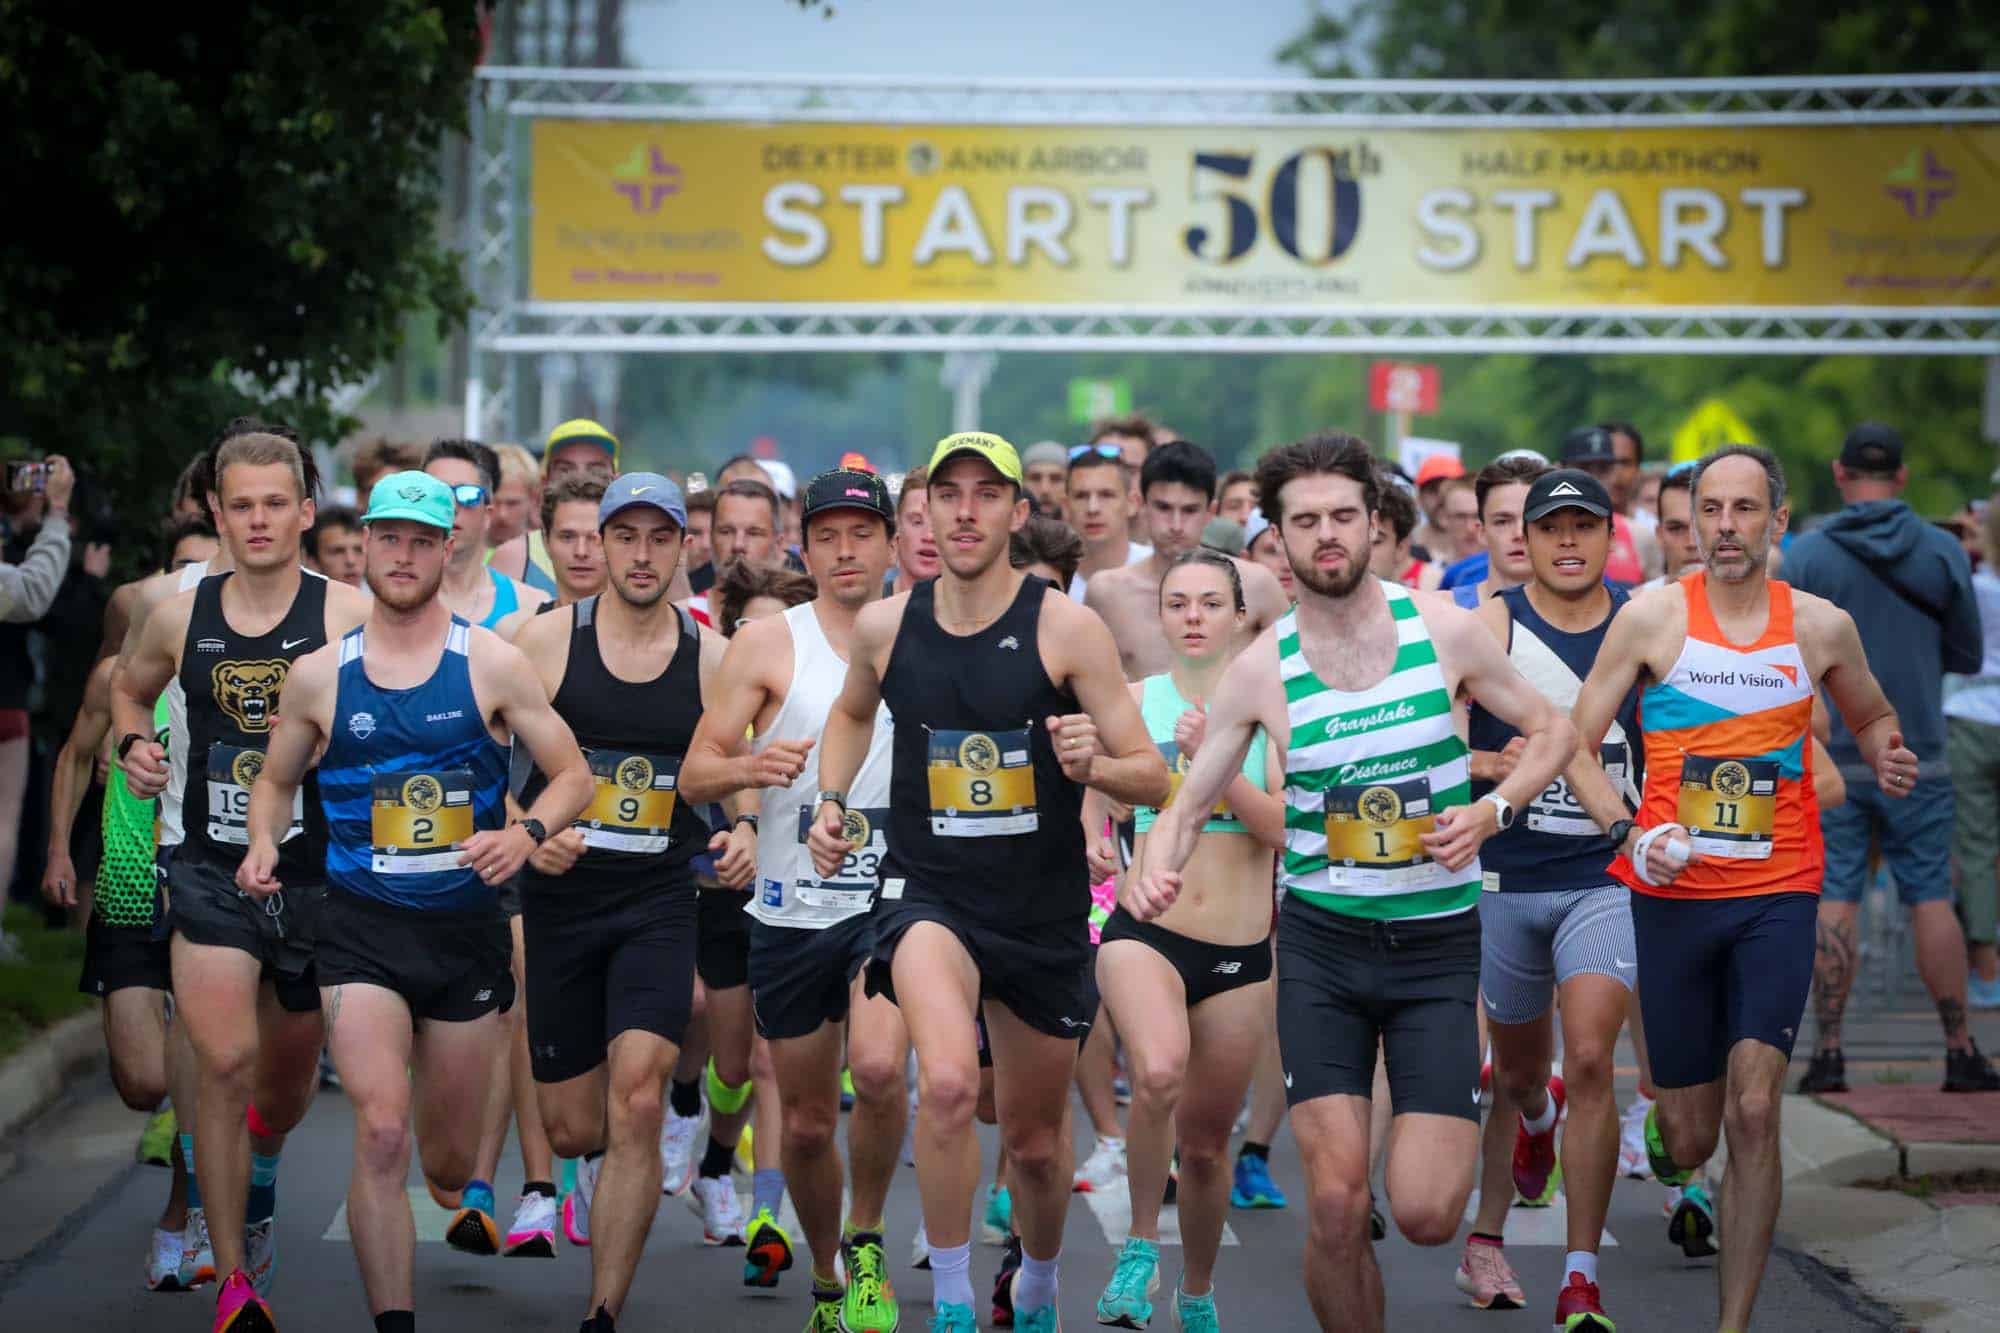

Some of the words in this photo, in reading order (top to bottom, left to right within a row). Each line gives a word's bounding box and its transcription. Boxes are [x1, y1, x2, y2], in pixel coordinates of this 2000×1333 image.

[762, 144, 896, 172] DEXTER
[947, 147, 1018, 172] ANN
[1027, 147, 1149, 173] ARBOR
[1461, 149, 1552, 175] HALF
[1563, 148, 1760, 175] MARATHON
[1180, 139, 1382, 267] 50th
[761, 180, 1153, 267] START
[1415, 187, 1808, 268] START
[1689, 671, 1734, 685] World
[1740, 673, 1783, 688] Vision
[1325, 701, 1416, 738] Grayslake
[1340, 757, 1417, 784] Distance
[971, 780, 992, 806] 8
[618, 797, 638, 822] 9
[1714, 802, 1739, 828] 11
[413, 818, 434, 843] 2
[1374, 831, 1389, 857] 1
